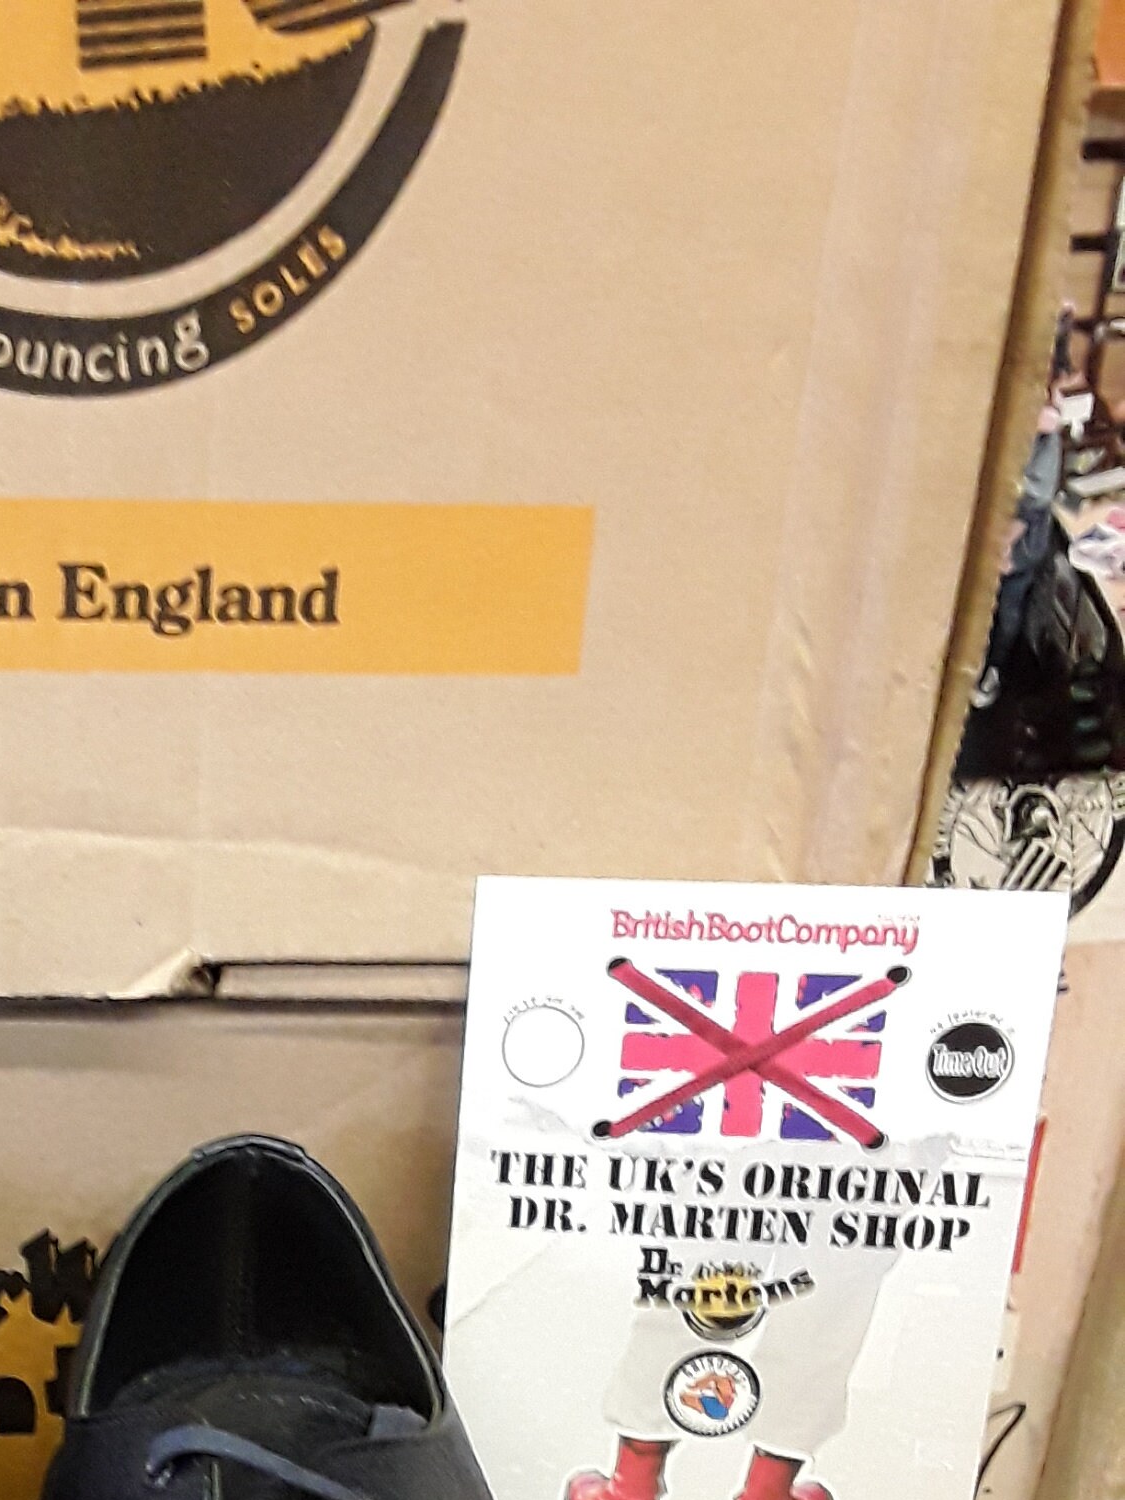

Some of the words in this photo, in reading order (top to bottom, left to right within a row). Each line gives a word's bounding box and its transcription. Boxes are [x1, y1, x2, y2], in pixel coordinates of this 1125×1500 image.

[228, 224, 349, 335] SOLES
[57, 561, 342, 637] England
[490, 1151, 589, 1190] THE
[606, 1153, 727, 1197] UK'S
[742, 1161, 991, 1209] ORIGINAL
[508, 1196, 589, 1233] DR.
[610, 1202, 811, 1250] MARTEN
[829, 1211, 971, 1253] SHOP
[633, 1268, 816, 1307] Martens
